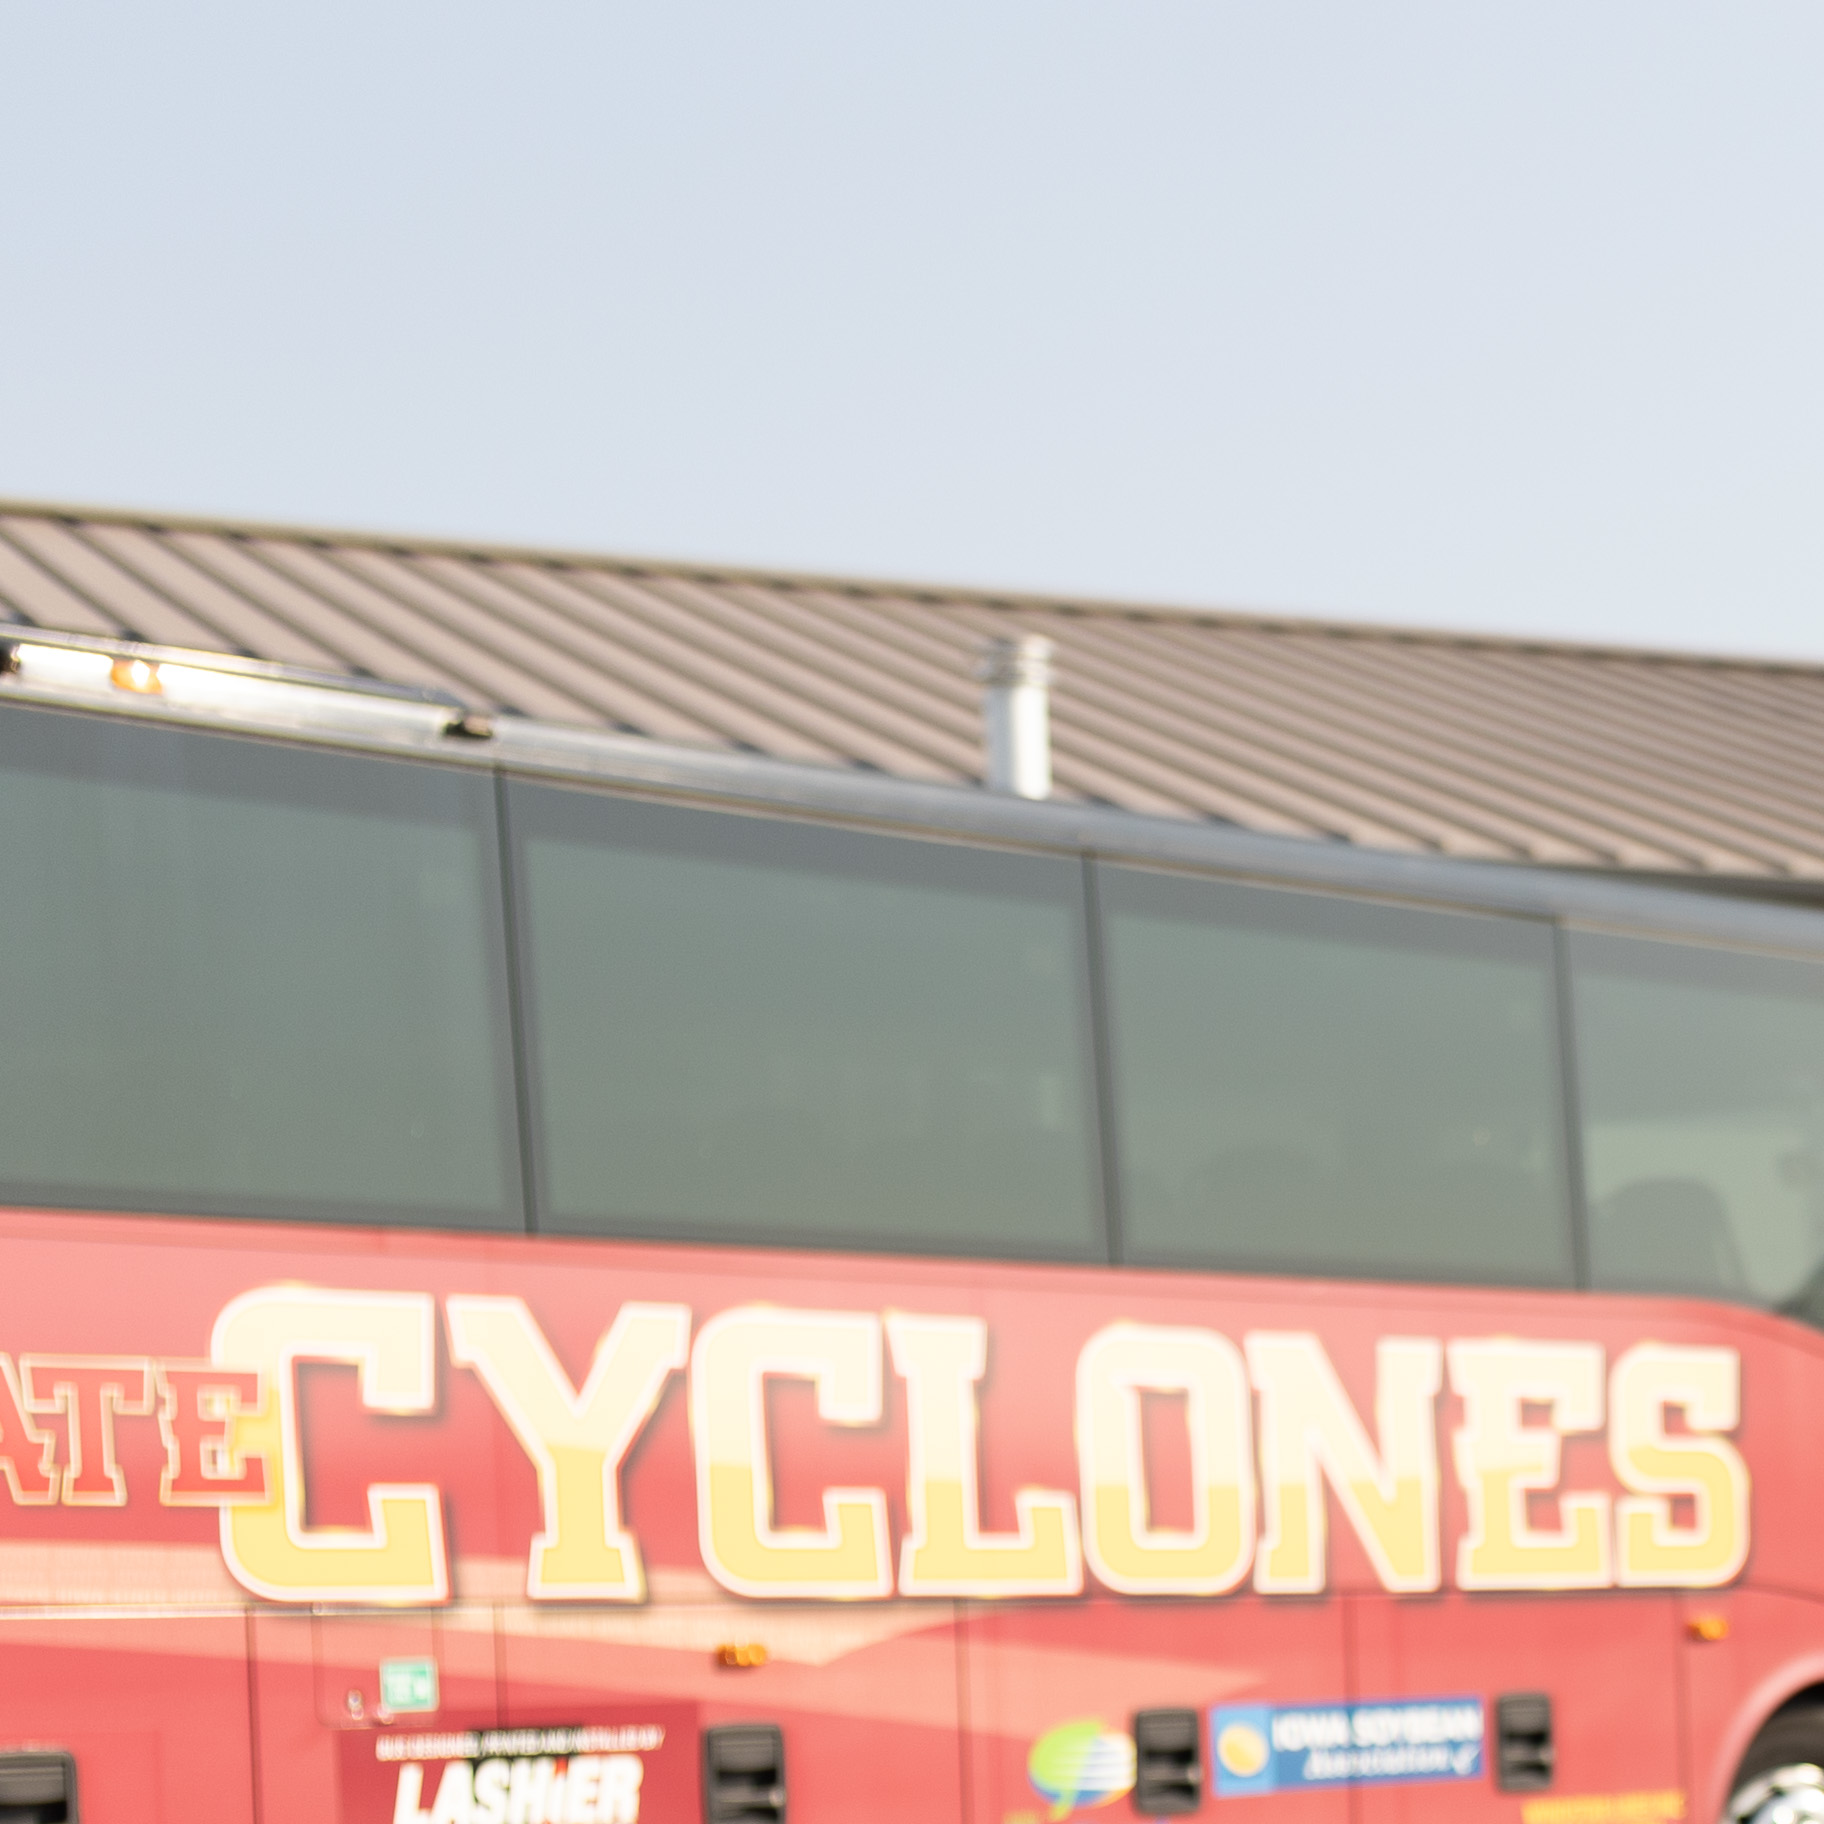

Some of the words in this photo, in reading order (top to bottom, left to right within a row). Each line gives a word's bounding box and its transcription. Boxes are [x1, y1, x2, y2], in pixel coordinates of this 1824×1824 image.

[210, 1282, 1752, 1602] CYCLONES
[1272, 1710, 1350, 1752] IOWA
[1351, 1704, 1485, 1748] SOYBEAN
